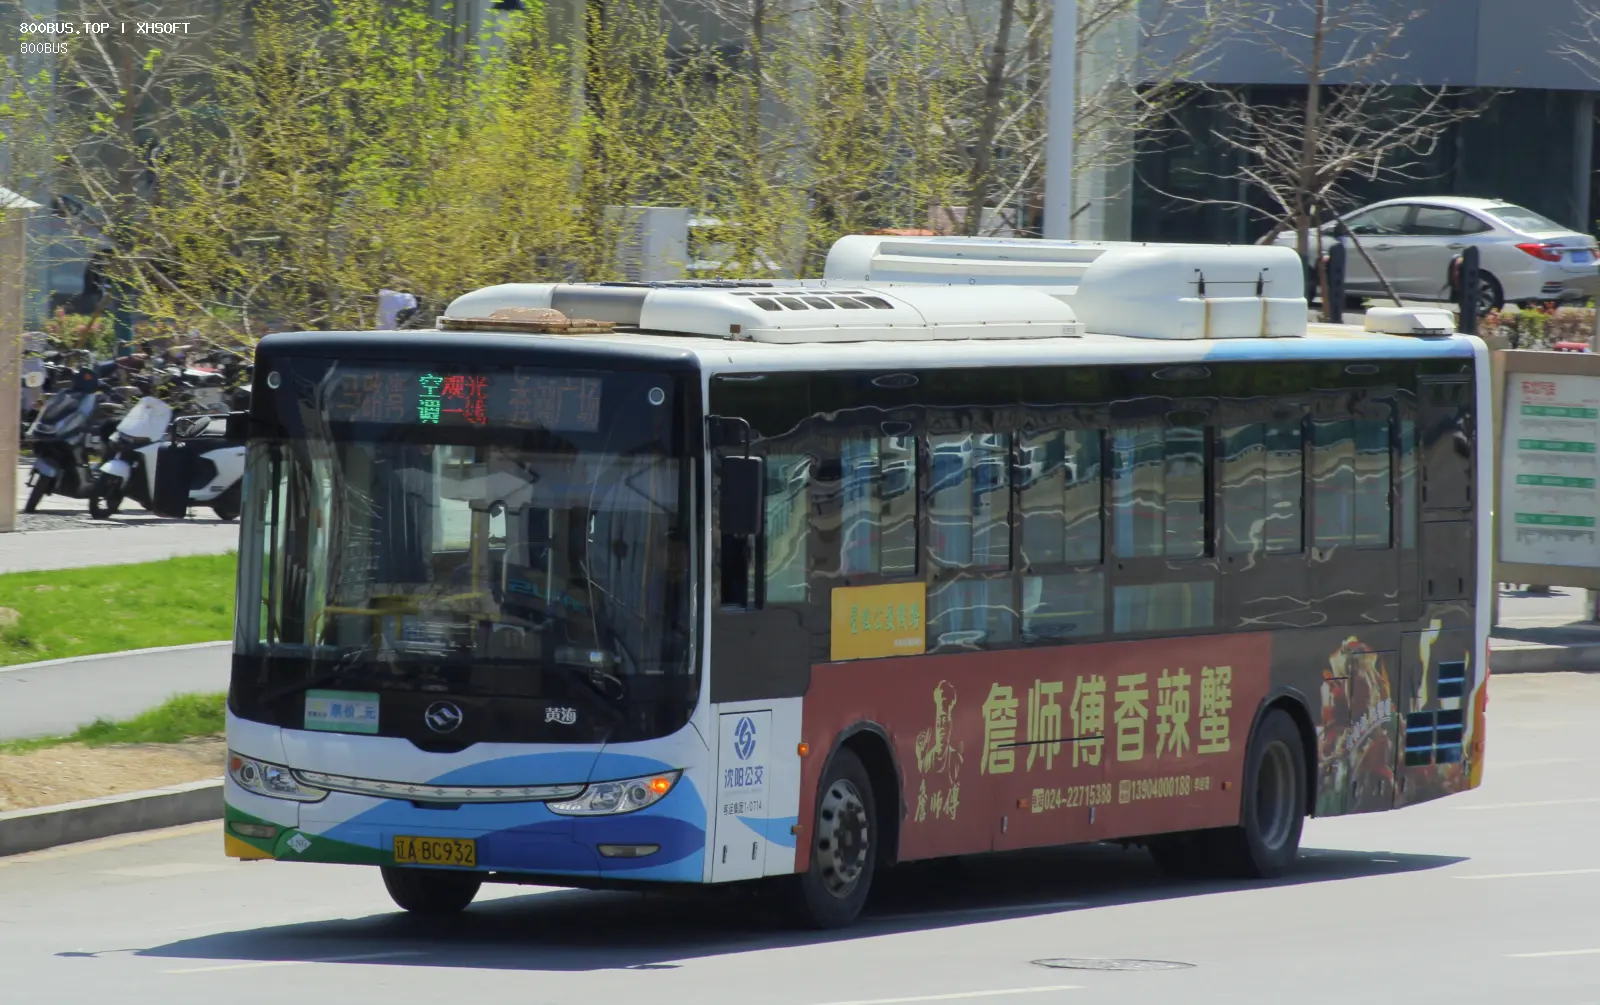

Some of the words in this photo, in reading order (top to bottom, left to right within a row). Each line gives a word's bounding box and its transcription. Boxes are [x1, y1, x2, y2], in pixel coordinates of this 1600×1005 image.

[545, 707, 576, 724] 黄海
[980, 665, 1232, 776] 詹师傅香辣蟹
[724, 766, 764, 788] 沈阳公交
